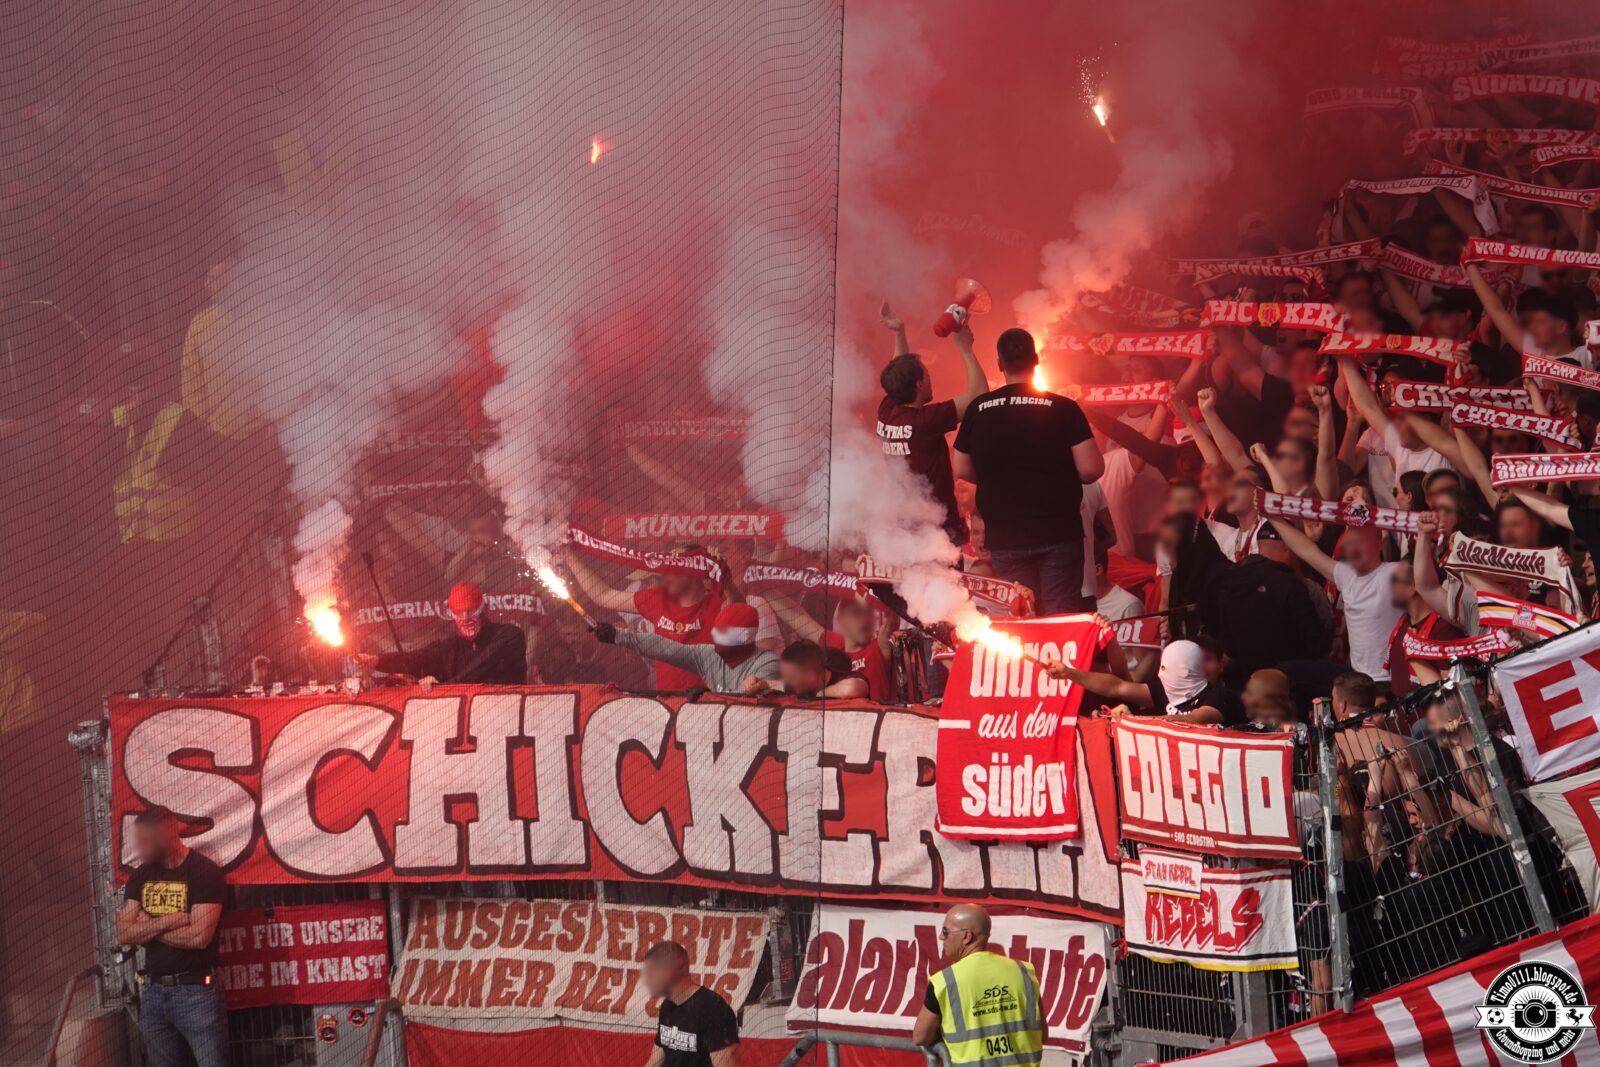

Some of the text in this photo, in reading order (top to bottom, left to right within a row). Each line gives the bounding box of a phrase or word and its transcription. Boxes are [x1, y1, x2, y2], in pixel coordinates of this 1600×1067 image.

[1474, 241, 1505, 256] WIR
[1508, 244, 1550, 262] SIND
[978, 396, 1053, 412] FIGHT FASCISM
[1457, 540, 1546, 575] alarMstufe
[978, 710, 1018, 739] aus
[1117, 727, 1290, 838] COLEGIO
[1145, 860, 1197, 887] STAY REBEL
[252, 919, 295, 950] FÜR
[300, 915, 384, 946] UNSERE
[1145, 886, 1264, 953] REBELS
[270, 960, 300, 986] IM
[306, 953, 386, 984] KNAST
[400, 958, 556, 1009] IMMER
[559, 961, 642, 1015] BEI
[983, 985, 1009, 999] SDS
